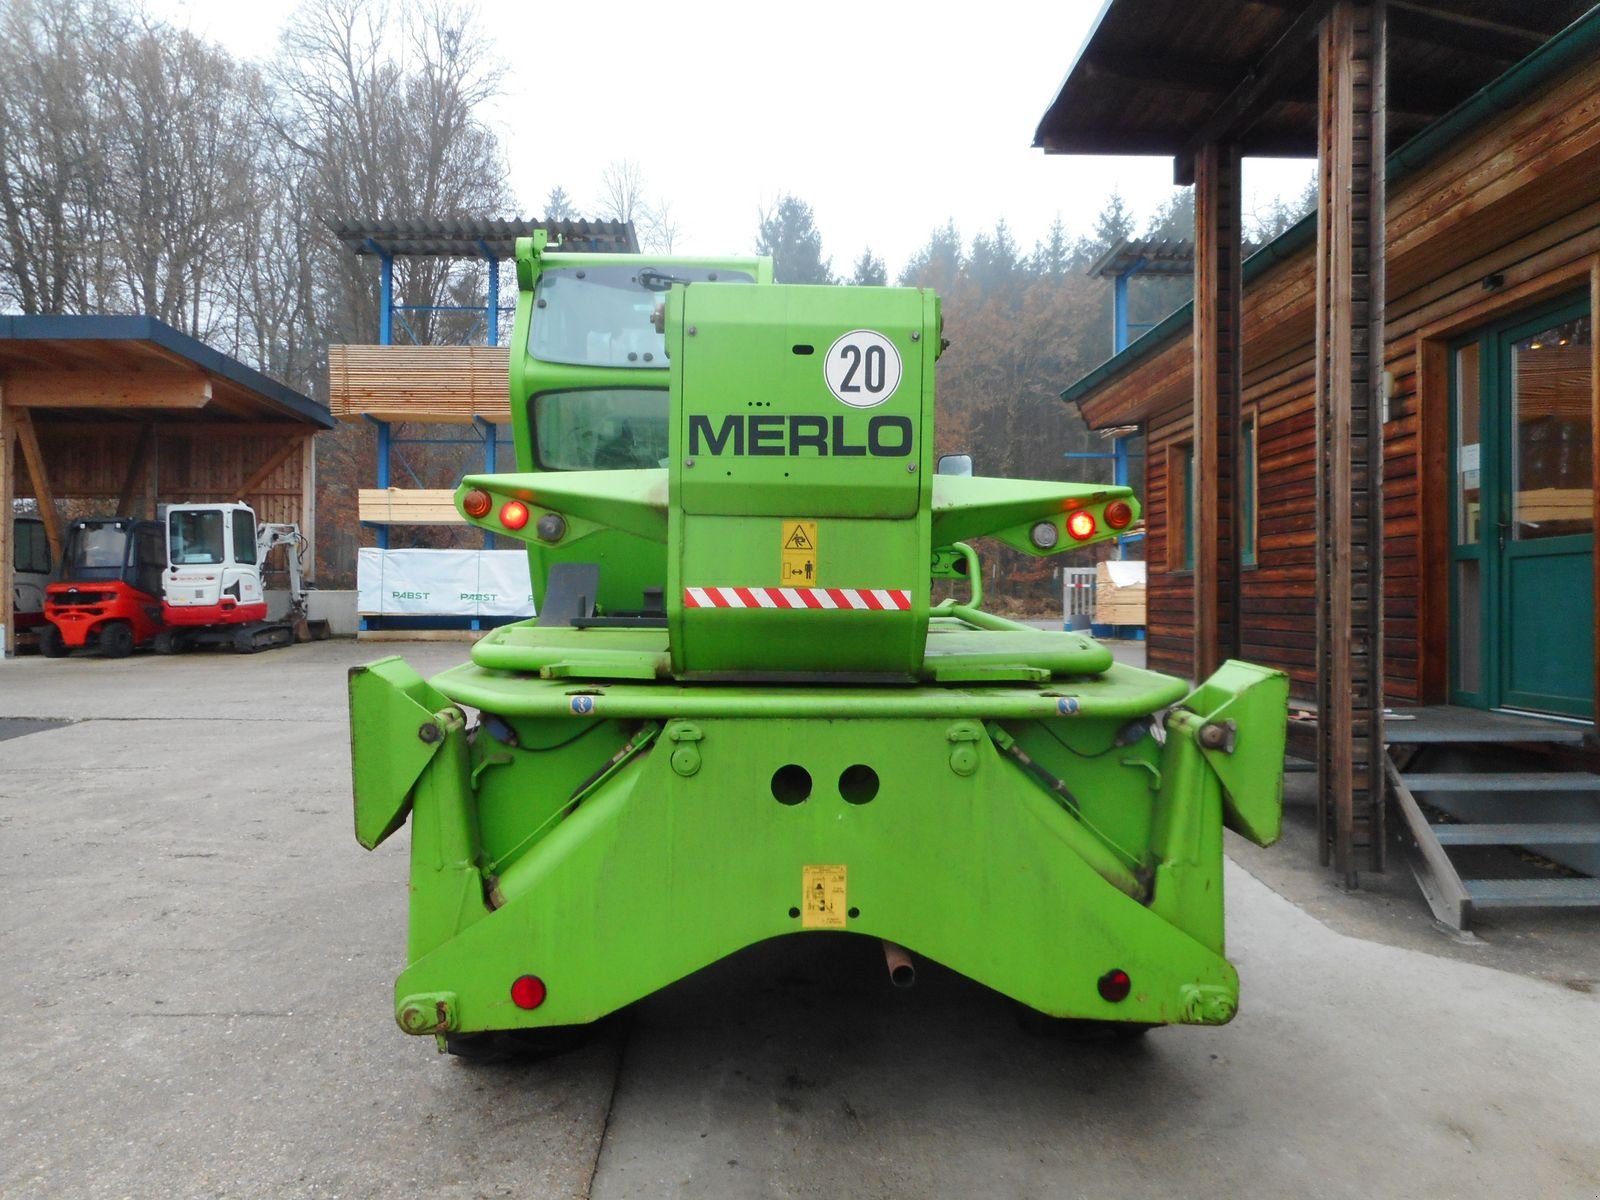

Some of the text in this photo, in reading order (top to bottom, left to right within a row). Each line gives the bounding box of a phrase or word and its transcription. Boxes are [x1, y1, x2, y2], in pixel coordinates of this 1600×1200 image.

[840, 344, 886, 394] 20
[688, 414, 913, 456] MERLO
[392, 591, 430, 600] PABST
[460, 593, 498, 601] PABST
